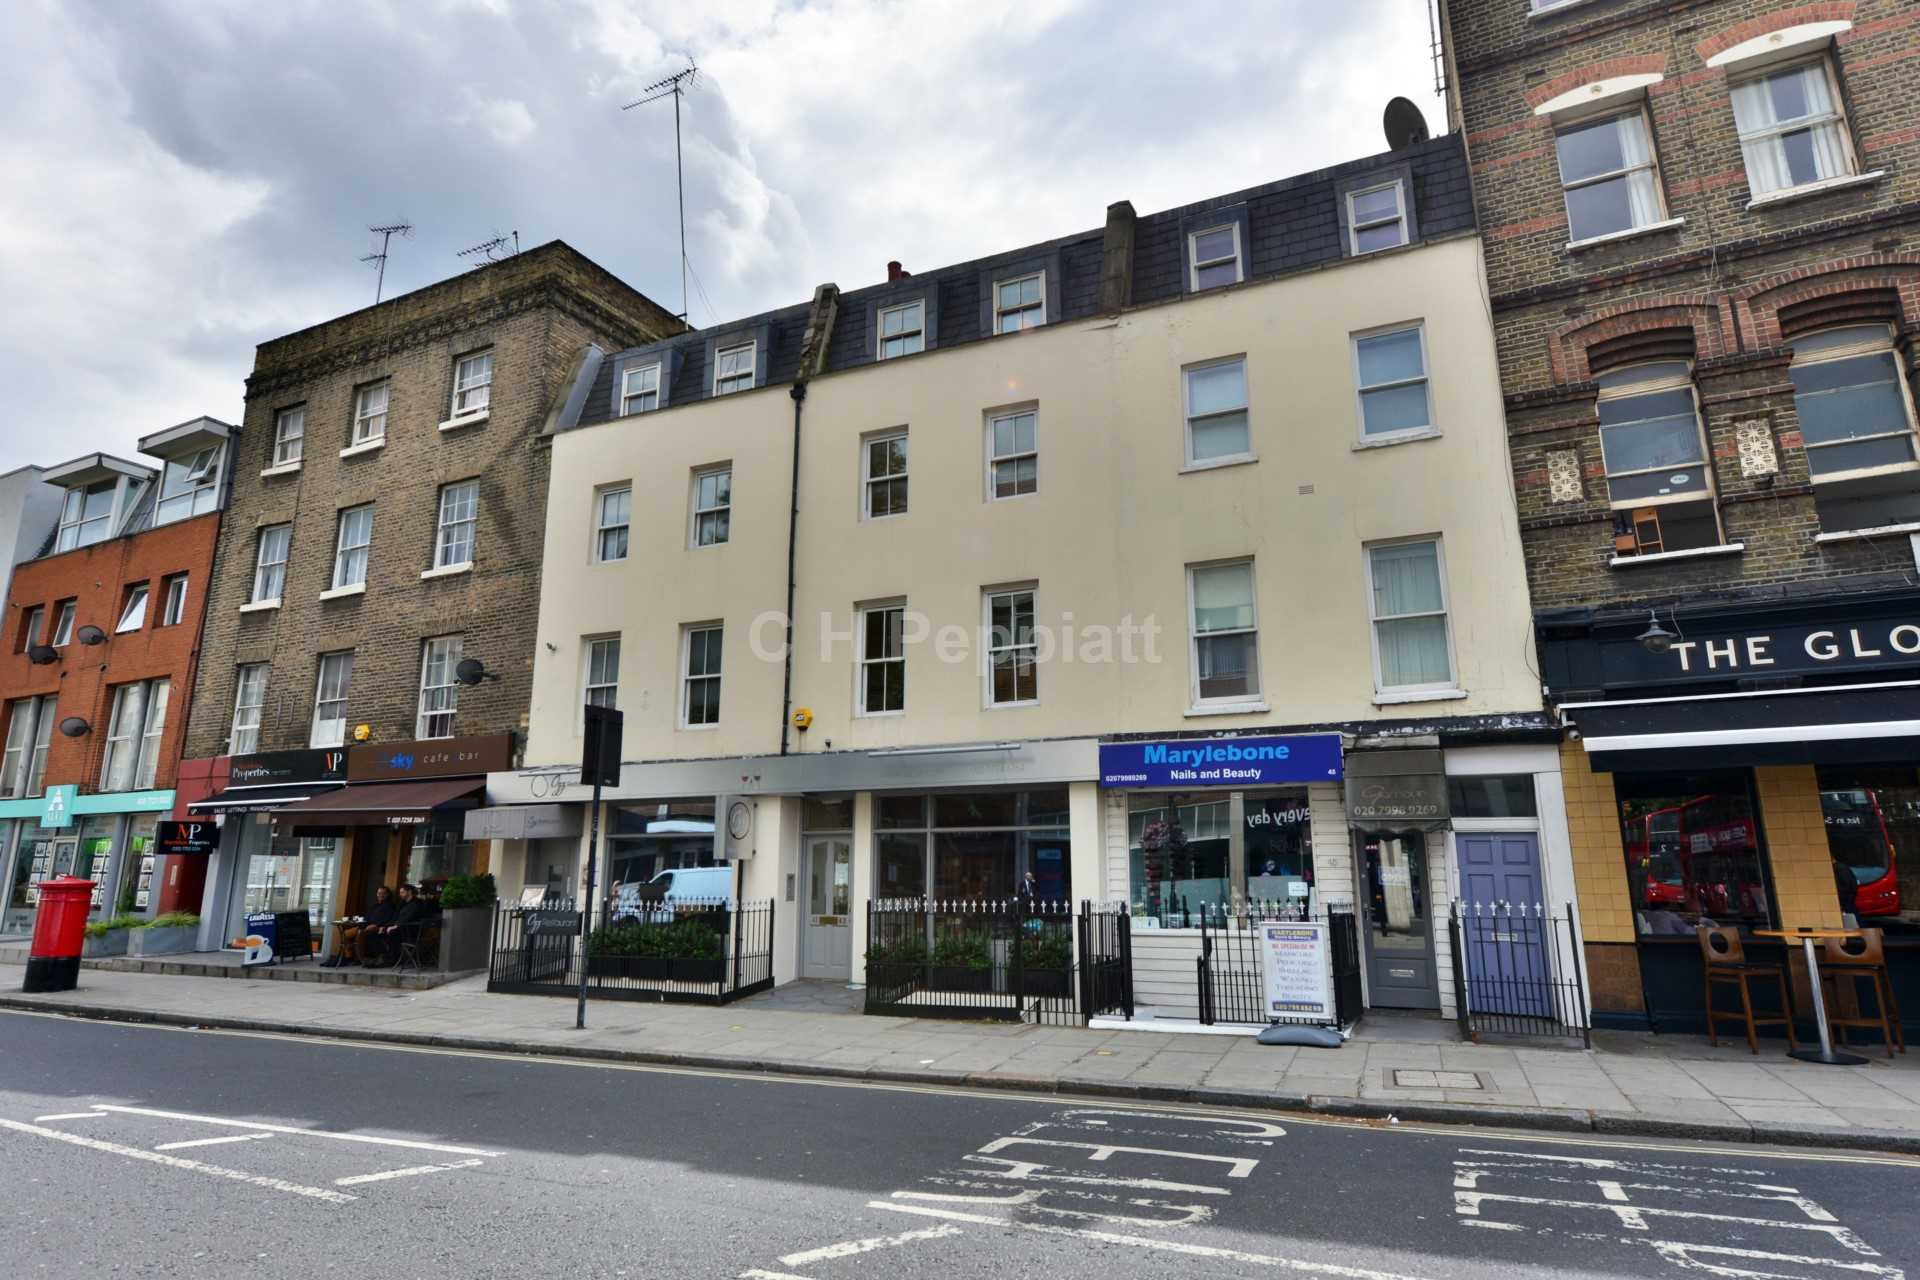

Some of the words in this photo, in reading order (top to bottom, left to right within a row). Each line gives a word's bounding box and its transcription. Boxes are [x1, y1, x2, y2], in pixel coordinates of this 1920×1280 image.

[1670, 635, 1774, 671] THE
[1804, 624, 1920, 660] GLO
[389, 752, 414, 771] sky
[423, 752, 449, 763] cafe
[459, 751, 480, 761] bar
[1143, 742, 1290, 768] Marylebone
[232, 765, 271, 780] Properties
[1170, 769, 1197, 780] Nails
[1200, 768, 1220, 779] and
[1223, 768, 1262, 781] Beauty
